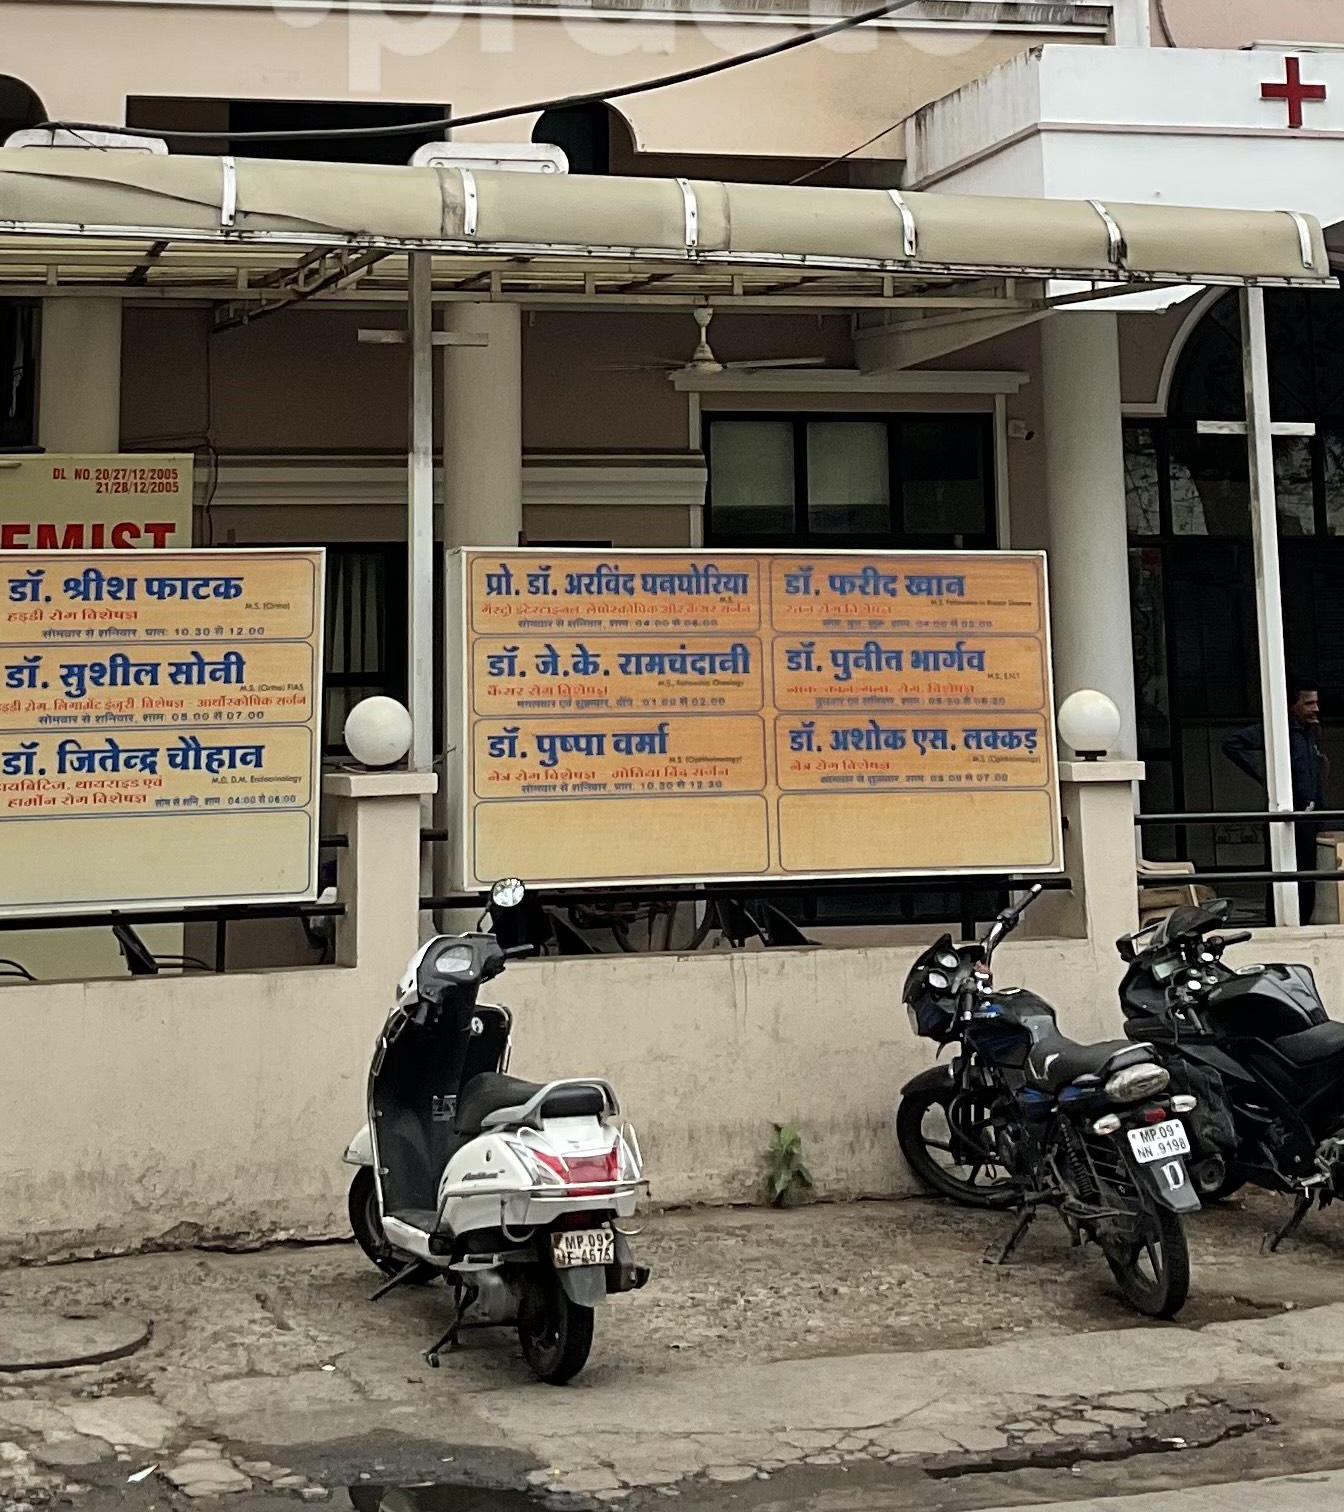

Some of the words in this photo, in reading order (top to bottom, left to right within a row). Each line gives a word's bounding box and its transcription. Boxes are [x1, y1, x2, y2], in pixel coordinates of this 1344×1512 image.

[8, 569, 52, 602] डॉ.
[63, 567, 136, 601] श्रीश
[145, 576, 244, 600] फाटक
[486, 564, 520, 596] प्रो.
[527, 565, 558, 596] डॉ.
[564, 563, 635, 596] अरविंद
[785, 566, 820, 597] डॉ.
[829, 566, 898, 597] फरीद
[904, 575, 966, 597] खान
[49, 609, 77, 621] रोग
[5, 655, 48, 689] डॉ.
[60, 652, 161, 698] सुशील
[168, 650, 246, 685] सोनी
[487, 645, 527, 678] डॉ.
[618, 643, 750, 675] रामचंदानी
[786, 642, 822, 672] डॉ.
[830, 641, 903, 681] पुनीत
[911, 641, 985, 672] भार्गव
[528, 686, 555, 697] रोग
[488, 726, 527, 758] डॉ.
[536, 733, 606, 768] पुष्पा
[612, 722, 669, 756] वर्मा
[789, 721, 822, 752] डॉ.
[830, 720, 906, 751] अशोक
[912, 729, 955, 756] एस.
[962, 728, 1037, 754] लक्कड़
[3, 742, 46, 776] डॉ.
[57, 738, 160, 775] जितेन्द्र
[168, 736, 265, 774] चौहान
[815, 759, 839, 771] रोग
[515, 770, 541, 782] रोग
[62, 795, 89, 807] रोग
